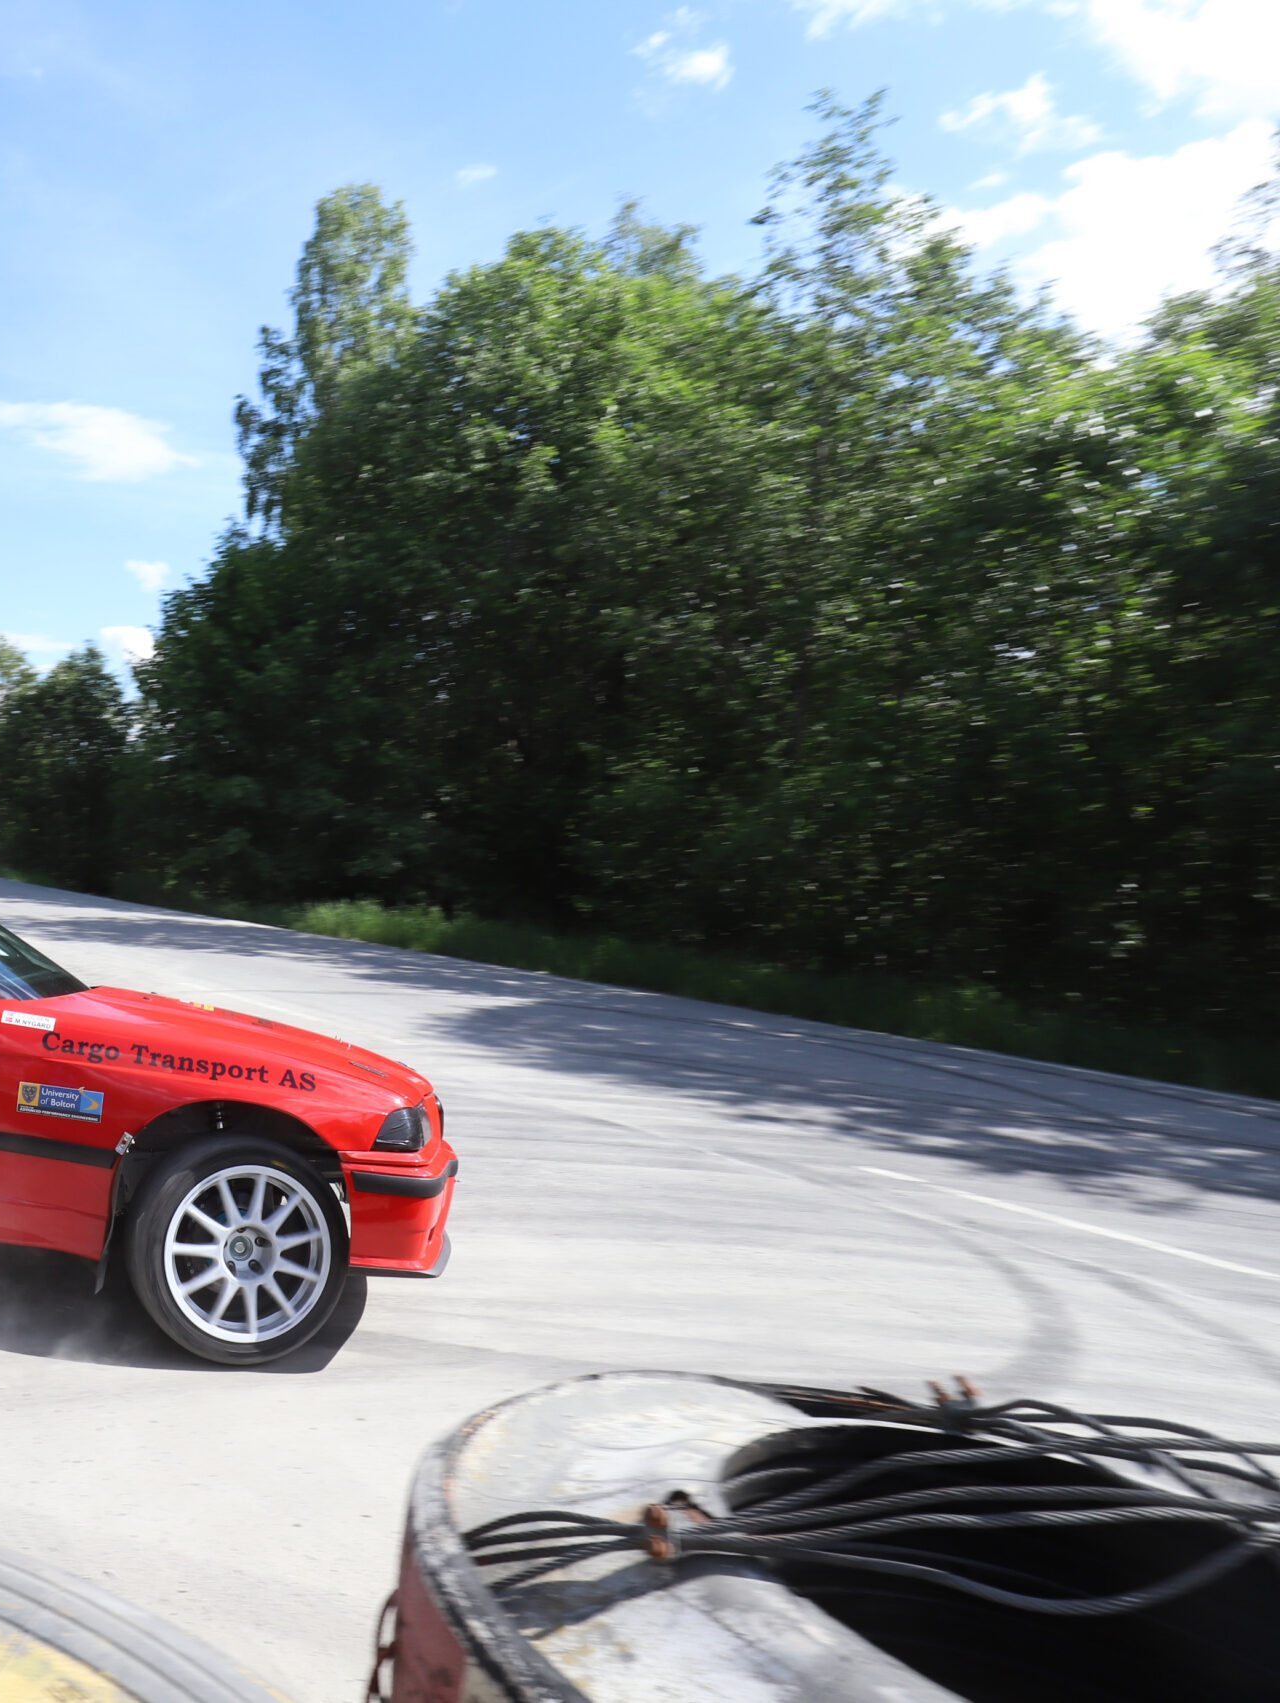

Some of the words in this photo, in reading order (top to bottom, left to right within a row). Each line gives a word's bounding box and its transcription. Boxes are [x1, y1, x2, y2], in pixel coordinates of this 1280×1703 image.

[42, 1031, 120, 1063] Cargo
[131, 1043, 269, 1083] Transport
[279, 1068, 317, 1092] AS
[41, 1087, 80, 1101] University
[40, 1097, 49, 1105] of
[50, 1098, 76, 1109] Bolton
